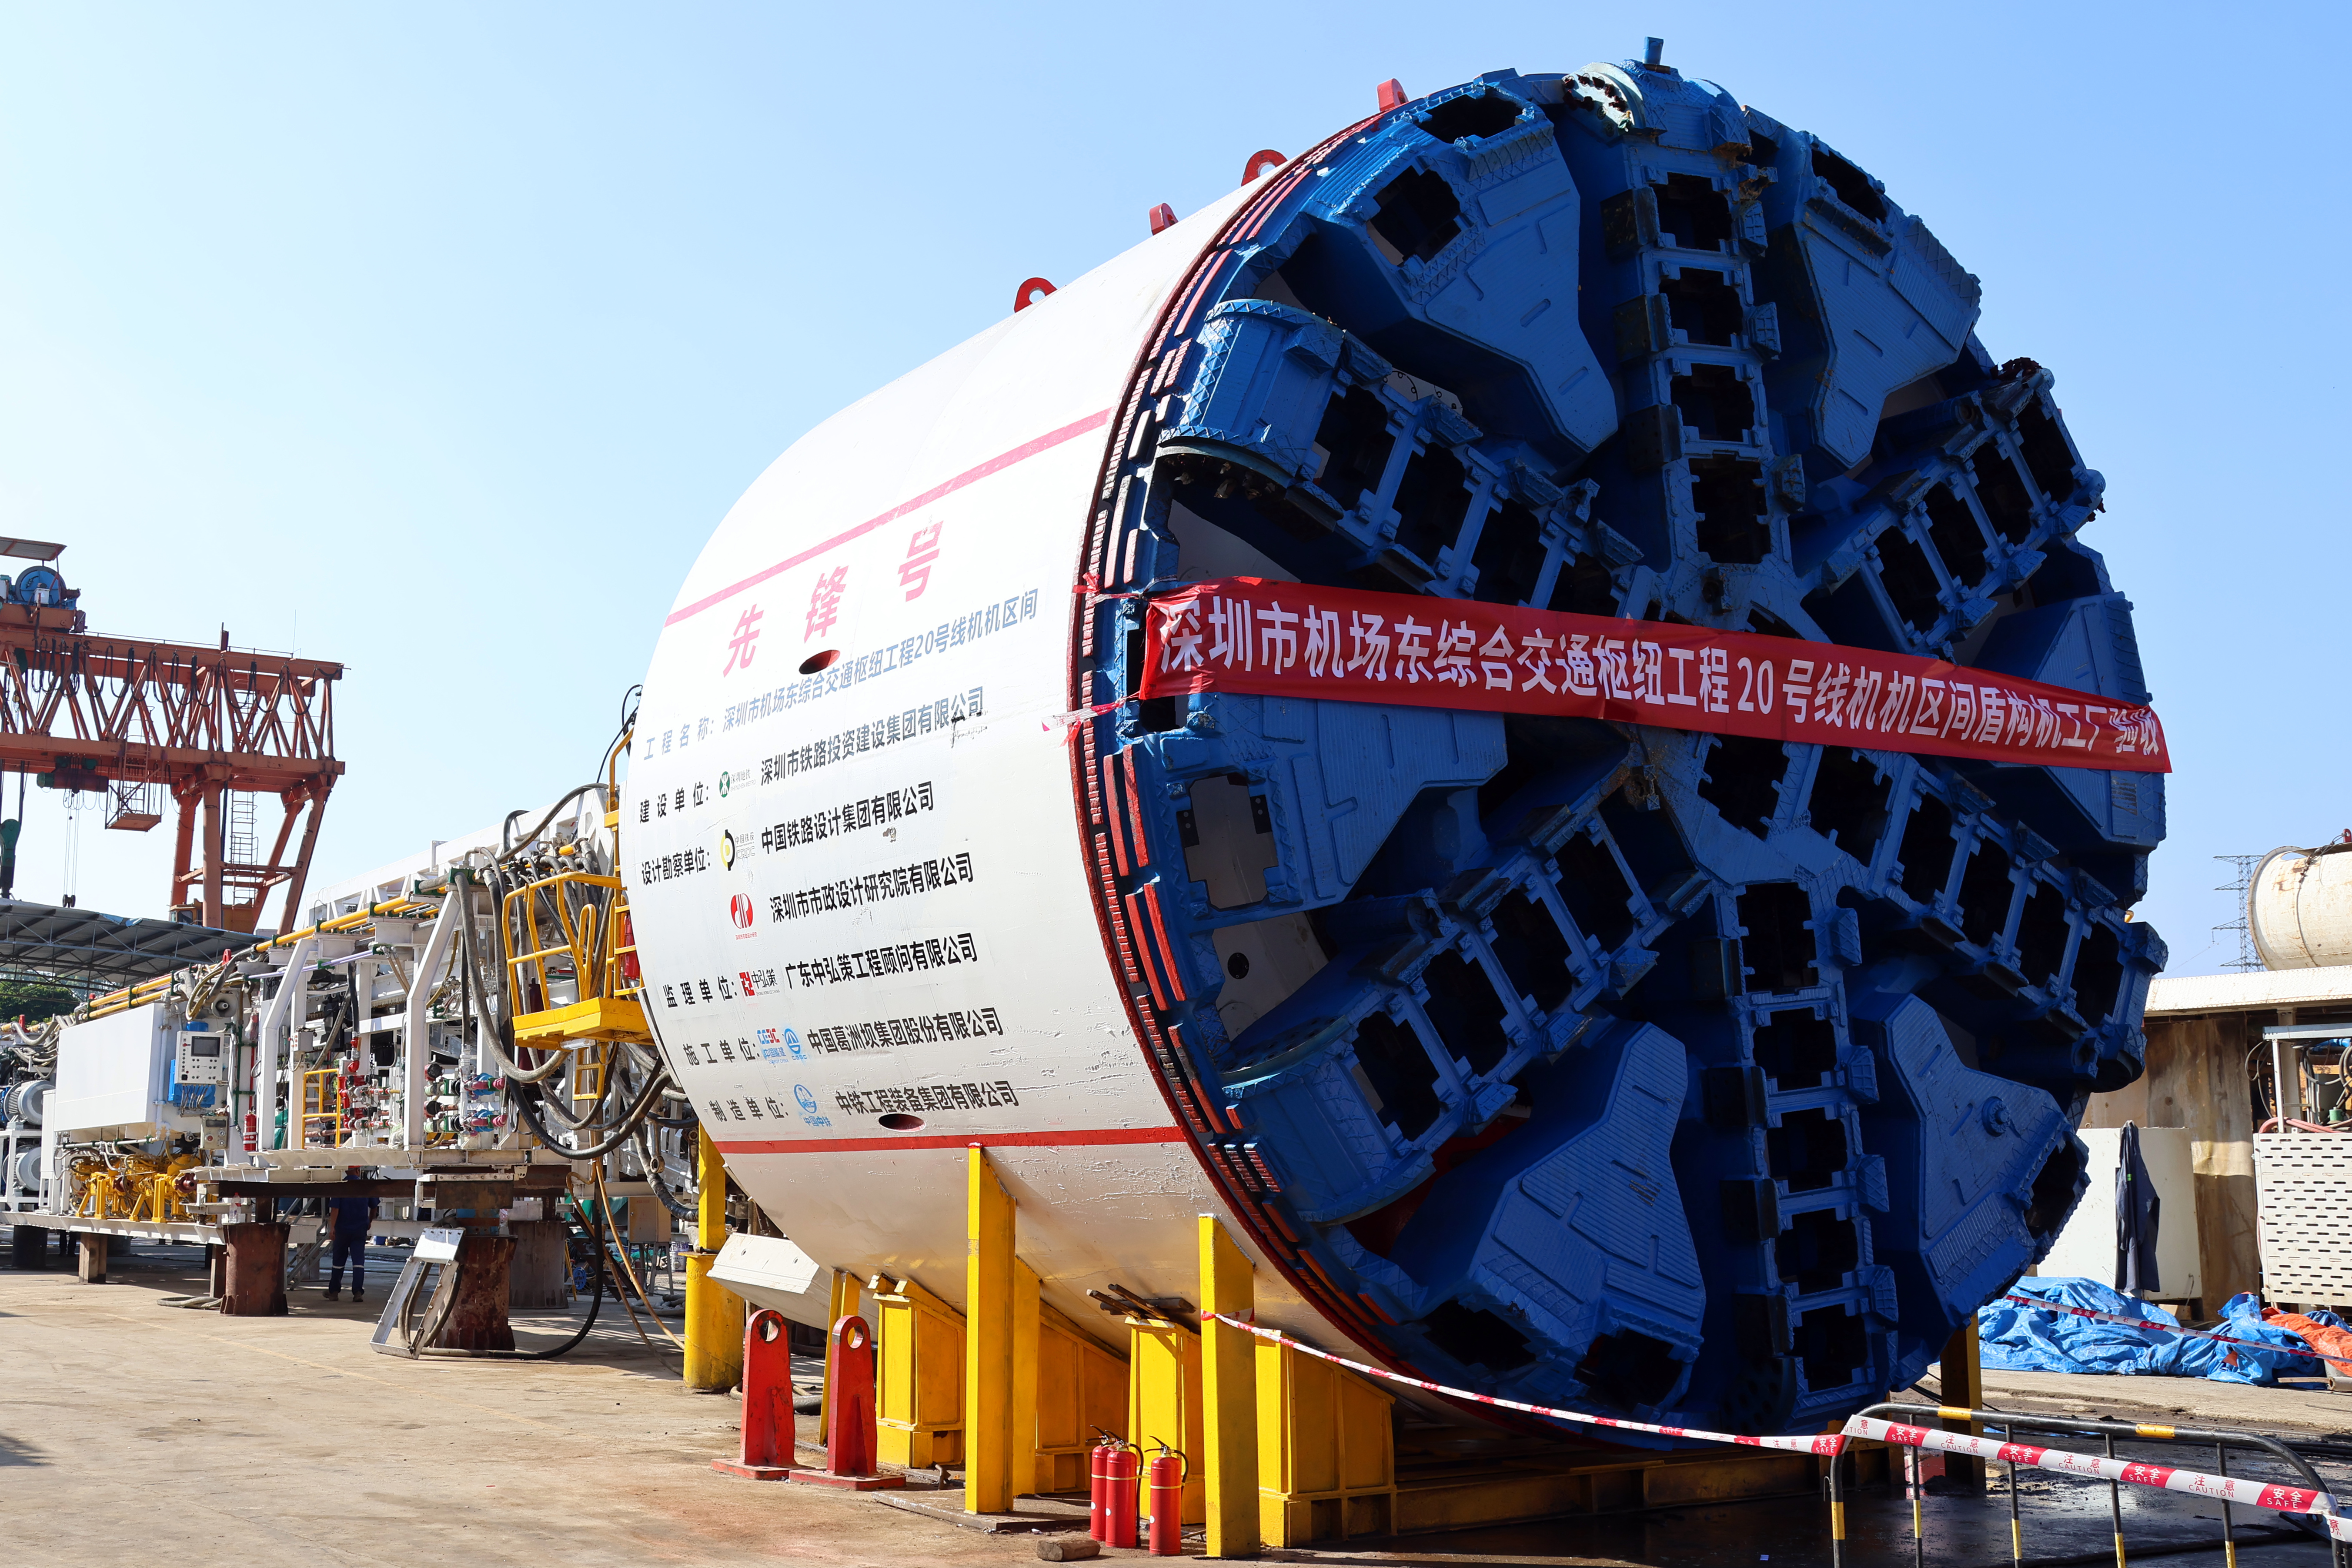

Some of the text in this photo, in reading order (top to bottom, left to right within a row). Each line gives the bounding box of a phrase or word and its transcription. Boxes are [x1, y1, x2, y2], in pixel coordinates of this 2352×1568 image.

[723, 520, 944, 677] 先锋号
[723, 588, 1038, 732] 深圳市机场东综合交通枢纽工程20号线机机区间
[1159, 595, 2159, 756] 深圳市机场东综合交通枢纽工程20号线机机区间盾构机工厂验收
[761, 686, 983, 786] 深圳市铁路投资建设集团有限公司
[761, 781, 934, 855] 中国铁路设计集团有限公司
[735, 832, 754, 845] 中国铁设
[769, 852, 974, 923] 深圳市市政设计研究院有限公司
[785, 933, 978, 989] 广东中弘策工程顾问有限公司
[751, 968, 778, 989] 中弘策
[807, 1007, 1003, 1055] 中国葛洲坝集团股份有限公司
[763, 1047, 786, 1058] 中国能建
[835, 1080, 1020, 1116] 中铁工程装备集团有限公司
[803, 1116, 832, 1127] 中国中铁
[1844, 1426, 1868, 1435] UTION
[1895, 1426, 1918, 1439] 安全
[1773, 1438, 1797, 1448] 注意
[1819, 1437, 1838, 1448] 安全
[1891, 1434, 1914, 1444] SAFE
[1946, 1434, 1980, 1448] 注意
[1941, 1443, 1978, 1454] CAUTION
[2009, 1445, 2033, 1458] 安全
[2004, 1453, 2029, 1463] SAFE
[2064, 1454, 2101, 1469] 注意
[2058, 1462, 2100, 1474] CAUTION
[2134, 1465, 2160, 1479] 安全
[2128, 1474, 2156, 1484] SAFE
[2194, 1475, 2235, 1491] 注意
[2188, 1484, 2235, 1498] CAUTION
[2273, 1488, 2302, 1503] 安全
[2267, 1498, 2299, 1509] SAFE
